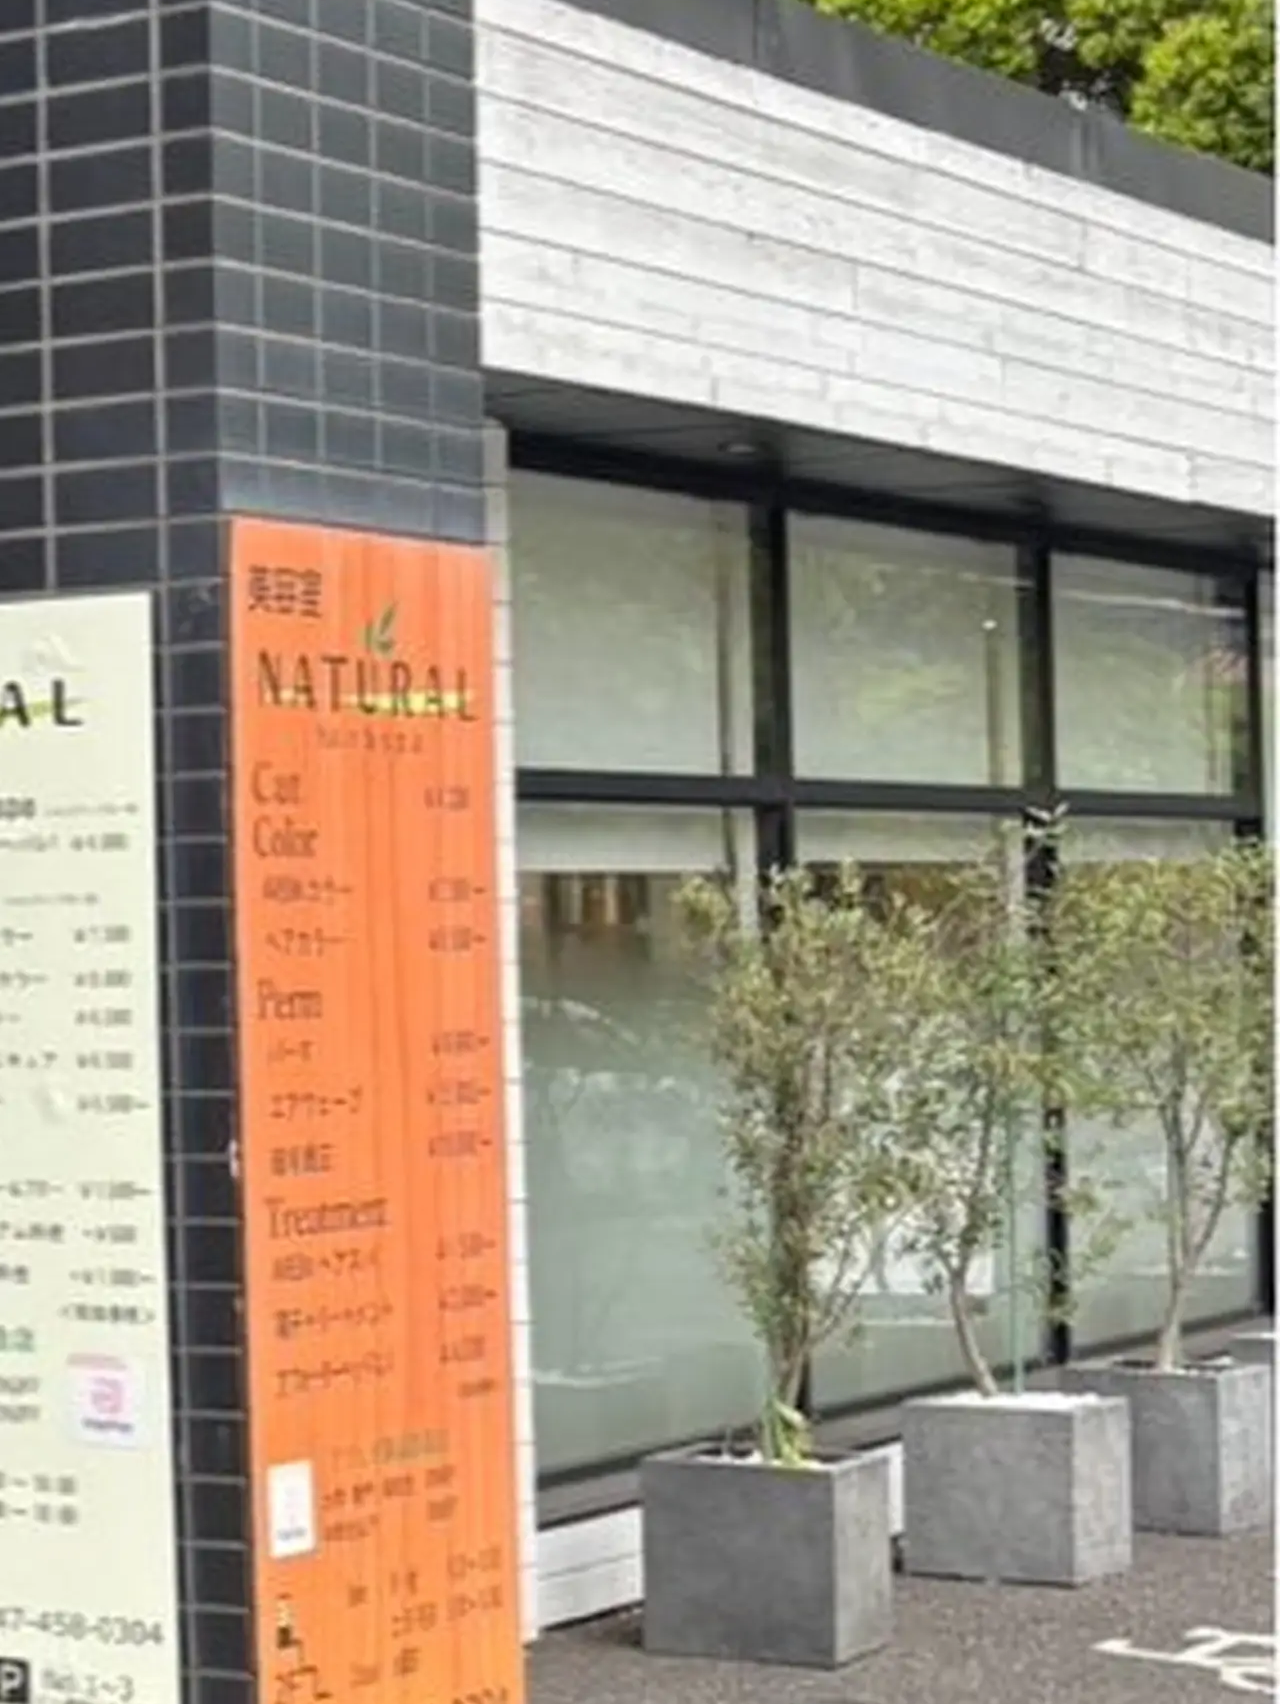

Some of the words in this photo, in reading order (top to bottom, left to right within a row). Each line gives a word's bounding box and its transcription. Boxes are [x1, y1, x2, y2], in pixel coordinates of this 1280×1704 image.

[248, 565, 323, 618] 美容室
[256, 649, 481, 722] NATURAL
